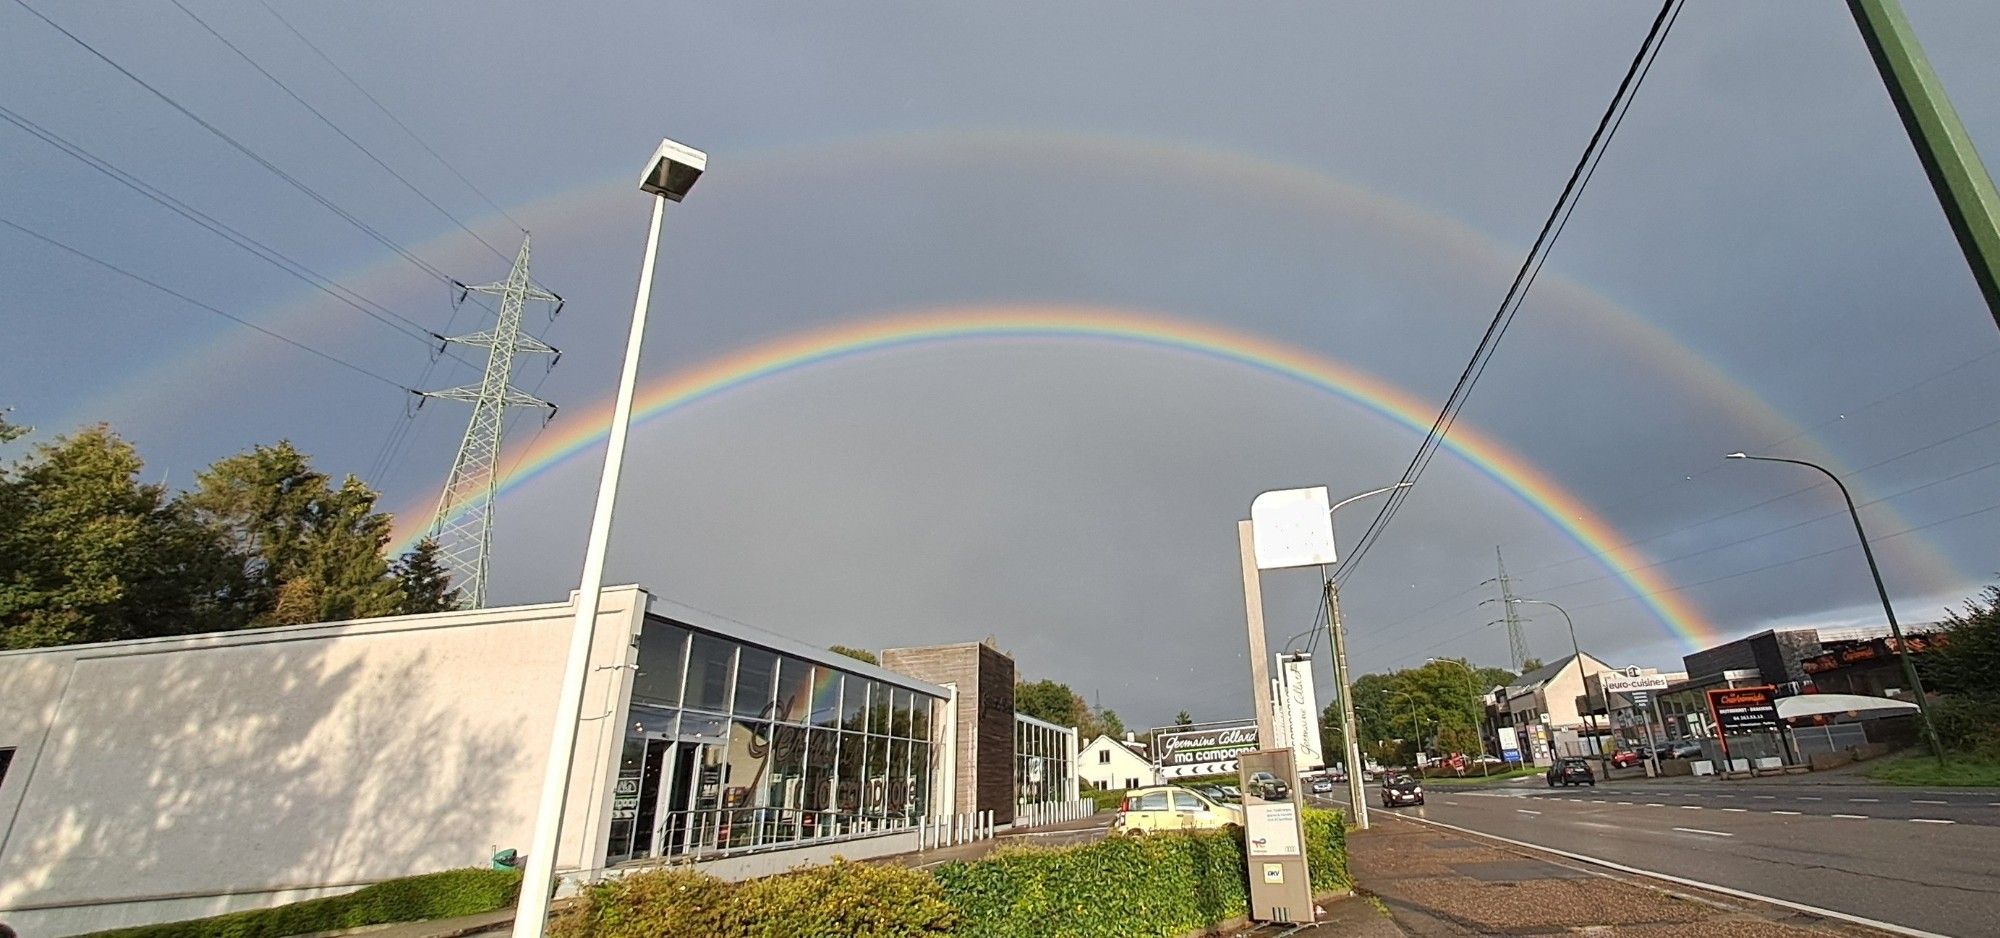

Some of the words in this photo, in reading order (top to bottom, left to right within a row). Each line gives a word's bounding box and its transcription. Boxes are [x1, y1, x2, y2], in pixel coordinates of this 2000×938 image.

[1608, 678, 1665, 690] euro-cuisines
[1161, 735, 1216, 760] Germaine
[1218, 728, 1258, 745] Collard
[1174, 751, 1193, 763] ma
